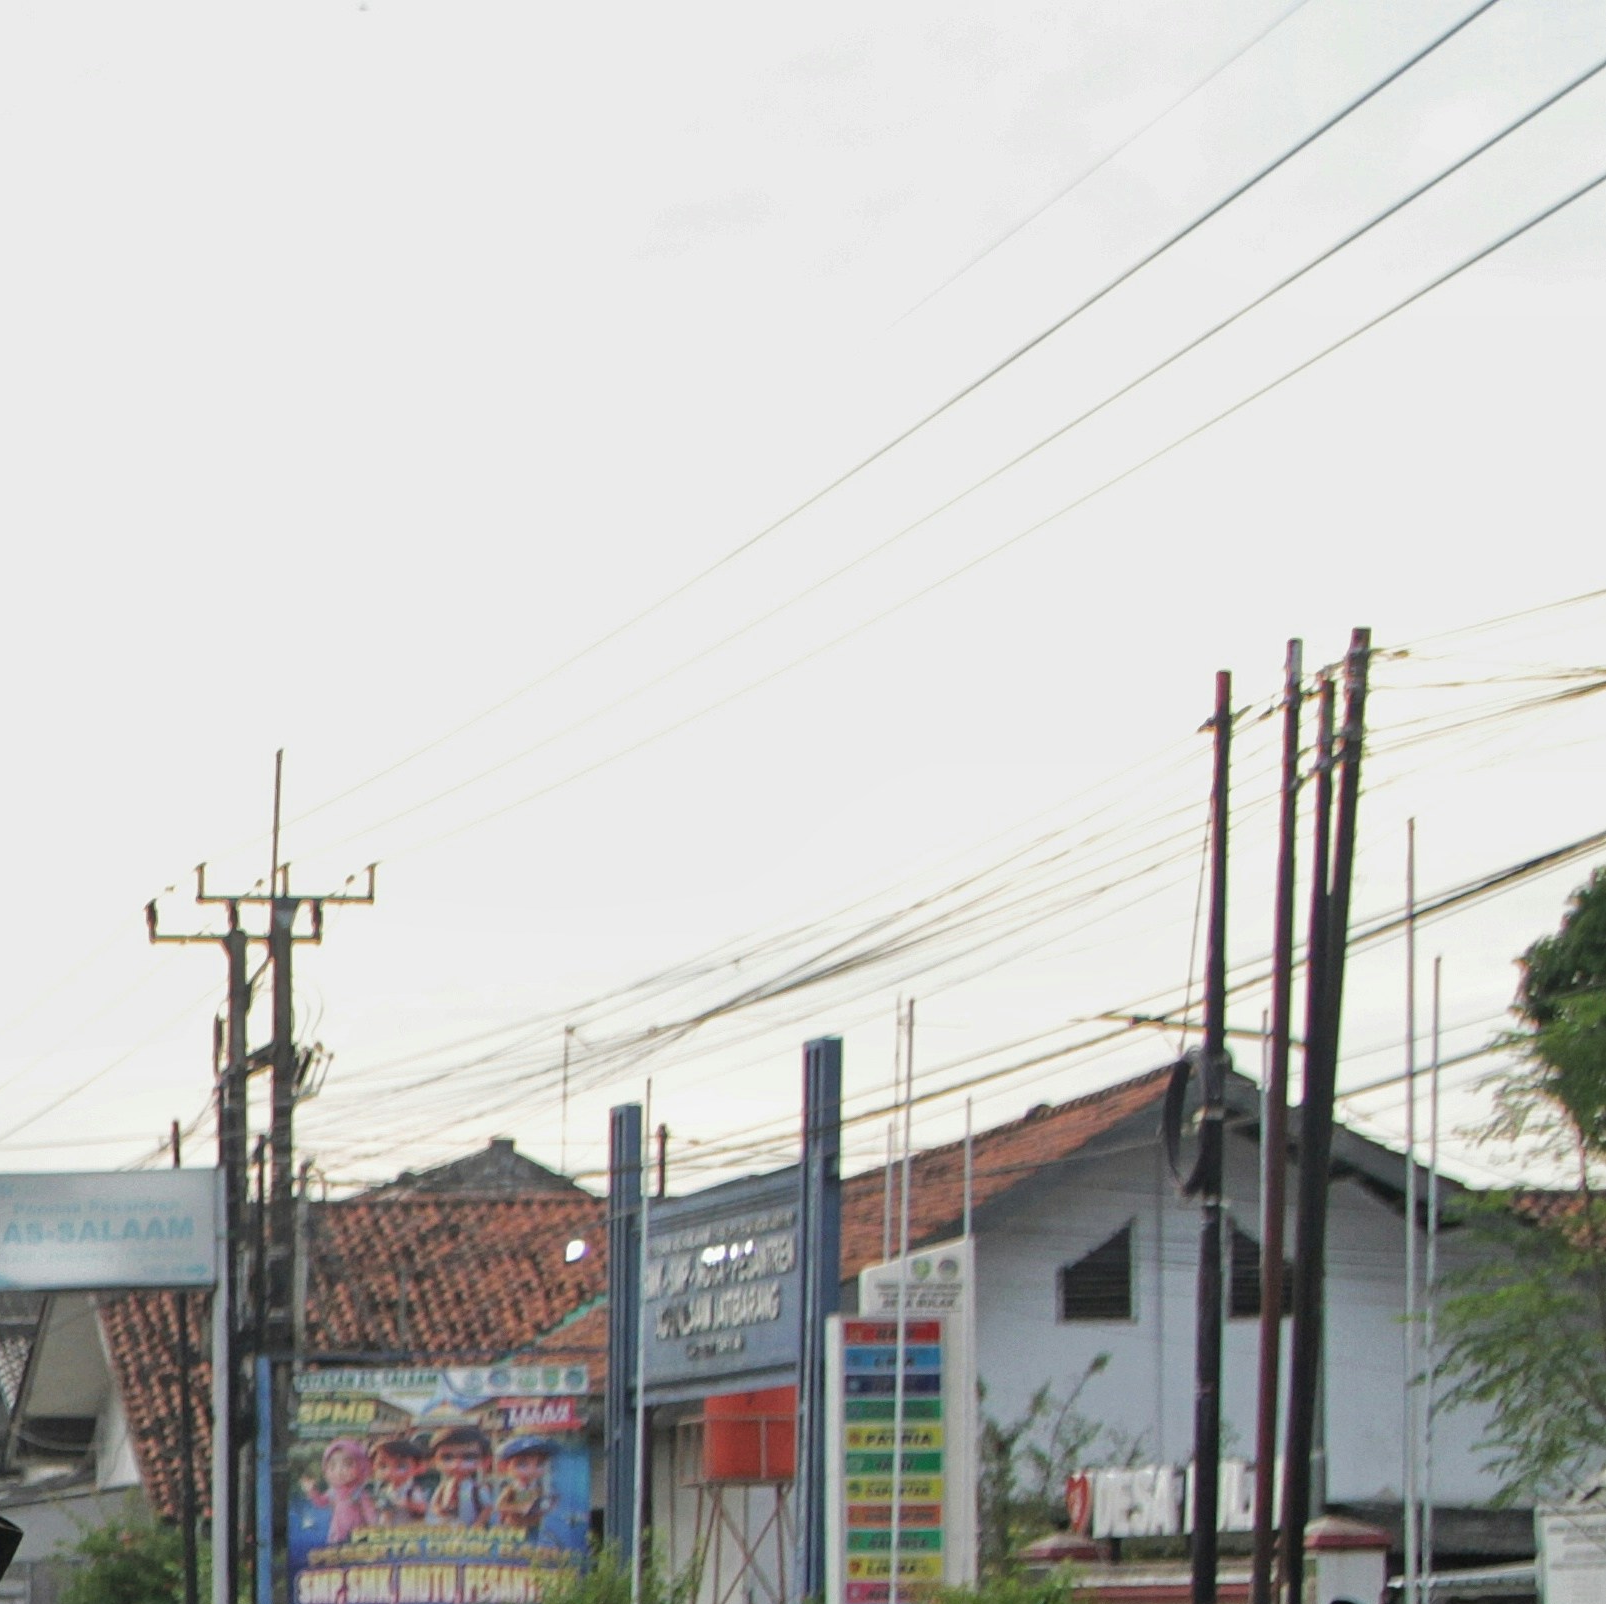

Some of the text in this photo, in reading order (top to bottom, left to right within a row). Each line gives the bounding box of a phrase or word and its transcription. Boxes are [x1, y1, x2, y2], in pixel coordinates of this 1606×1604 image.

[1, 1215, 195, 1245] AS-SALAAM
[298, 1400, 376, 1424] SPMB
[1091, 1464, 1183, 1538] DESA
